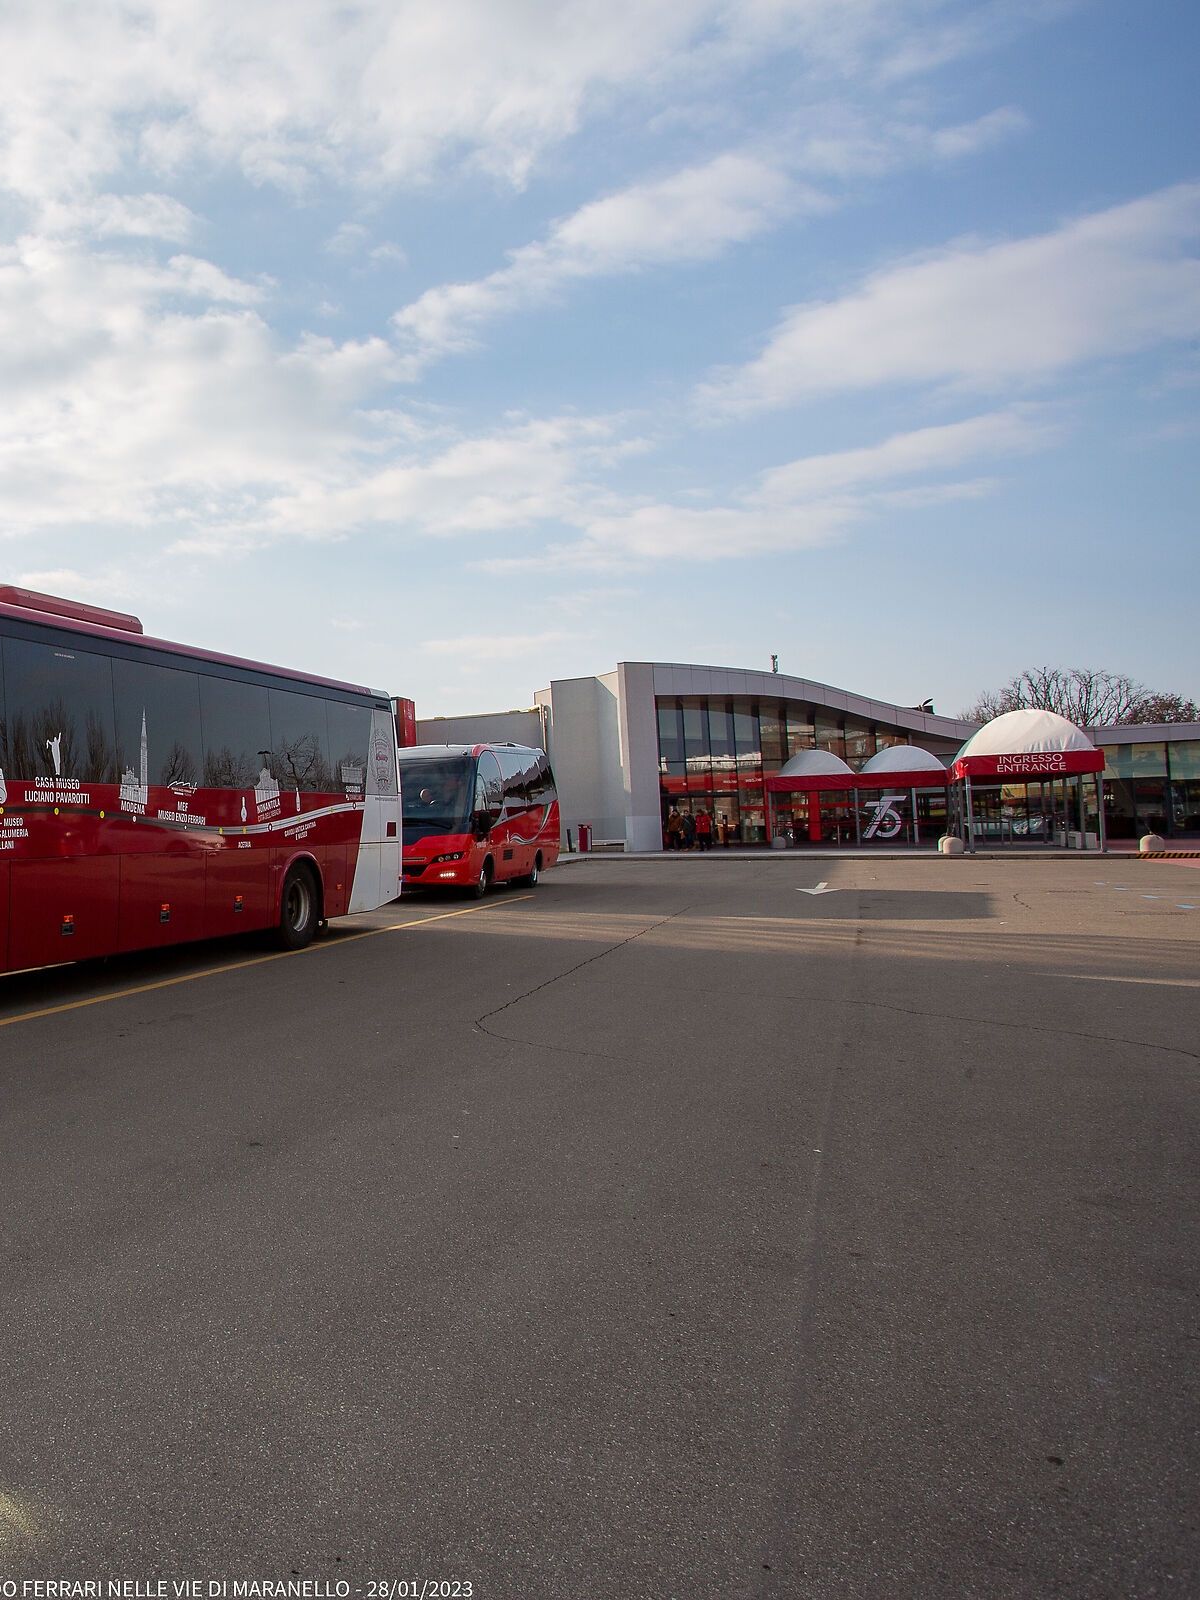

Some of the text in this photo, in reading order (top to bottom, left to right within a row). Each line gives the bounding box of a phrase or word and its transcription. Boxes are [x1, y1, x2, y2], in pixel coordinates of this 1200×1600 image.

[998, 753, 1063, 764] INGRESSO
[996, 762, 1067, 773] ENTRANCE
[34, 776, 80, 790] CASA MUSEO
[24, 790, 90, 804] LUCIANO PAVAROTTI
[120, 800, 146, 815] MODENA
[3, 818, 24, 827] MUSEO
